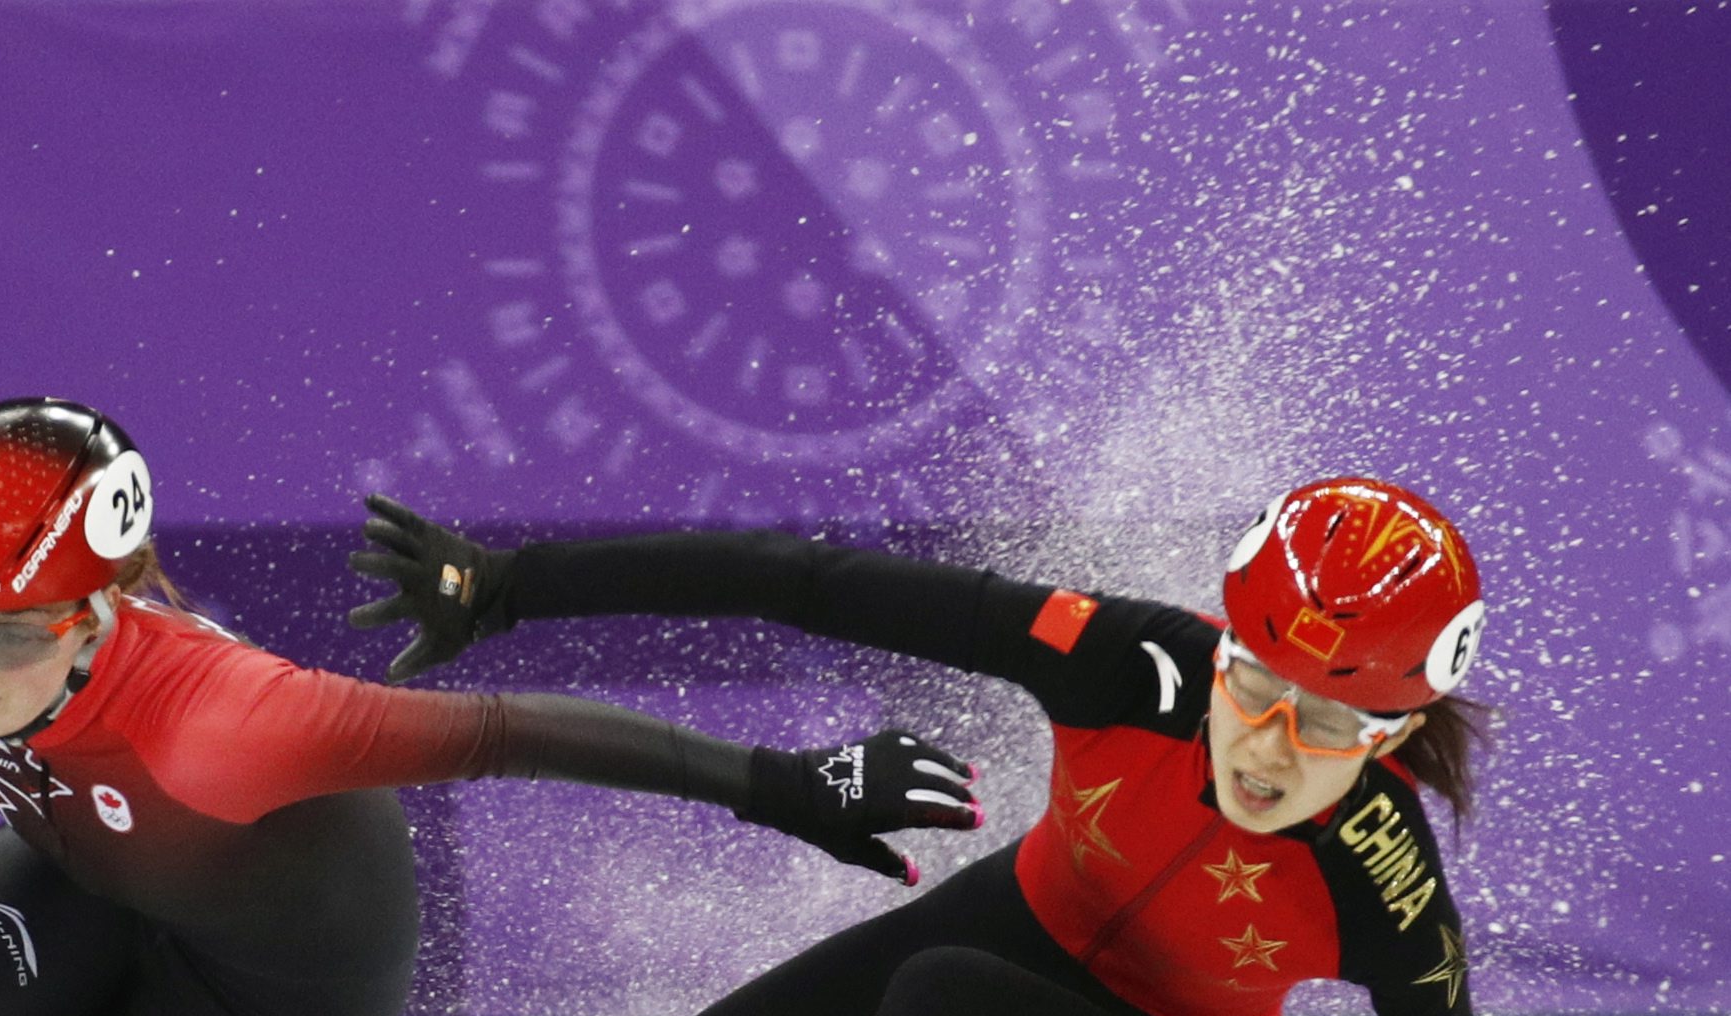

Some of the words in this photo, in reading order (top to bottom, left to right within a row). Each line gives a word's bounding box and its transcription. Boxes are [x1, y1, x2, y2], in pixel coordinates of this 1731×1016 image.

[22, 489, 83, 580] GARNEAU
[112, 471, 145, 537] 24
[850, 745, 865, 799] Canada
[1339, 792, 1437, 931] CHINA
